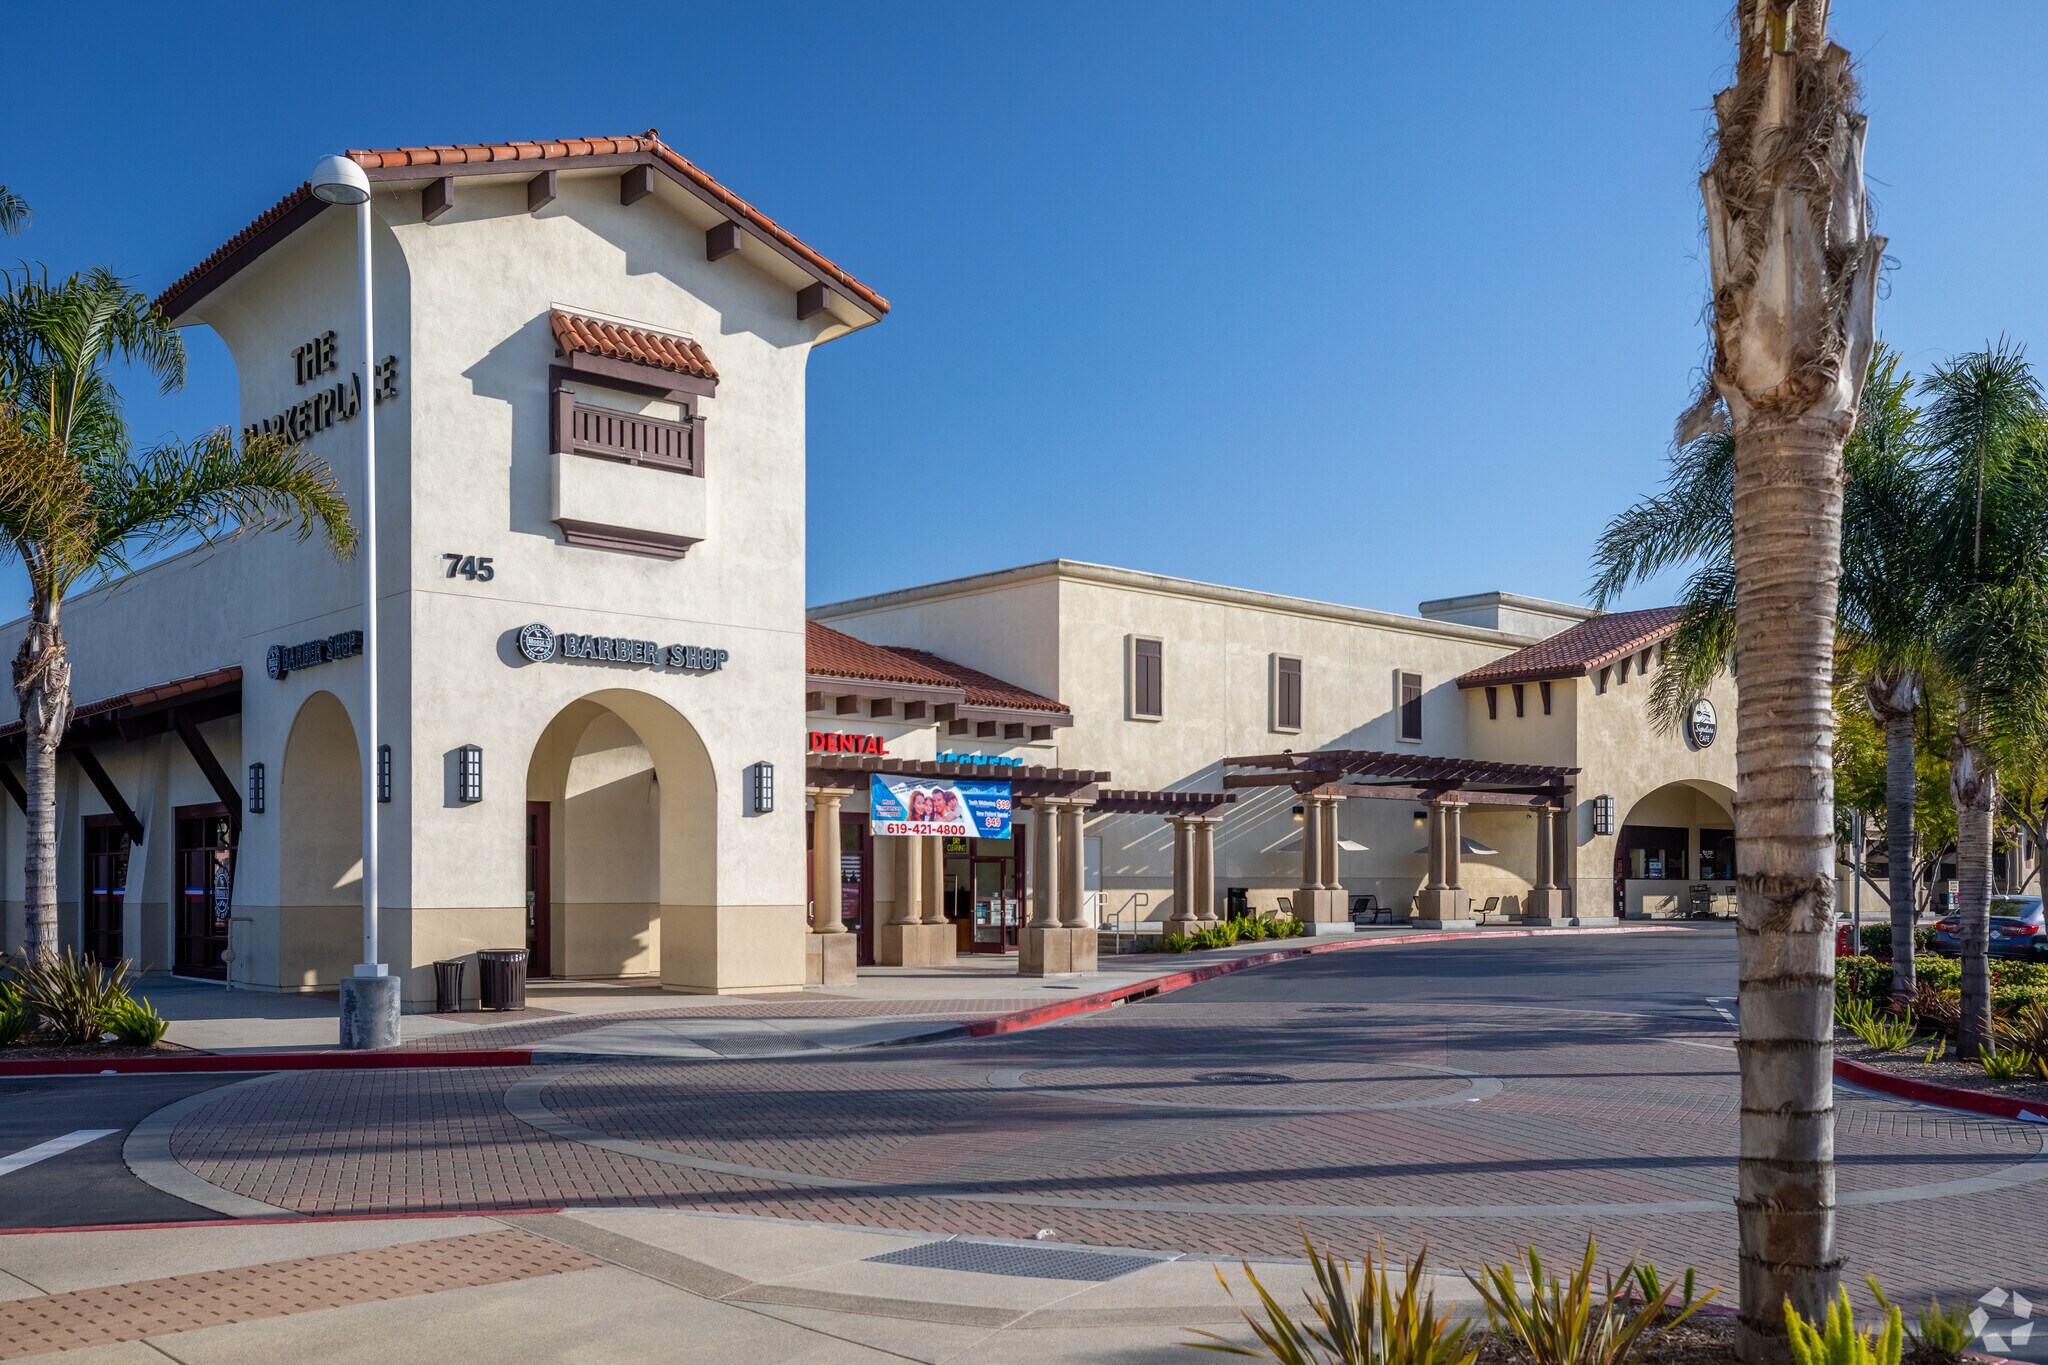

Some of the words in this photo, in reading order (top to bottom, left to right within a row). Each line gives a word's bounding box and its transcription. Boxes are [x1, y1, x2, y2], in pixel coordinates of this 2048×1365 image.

[291, 330, 335, 385] THE
[442, 553, 494, 582] 745
[282, 640, 325, 671] BARBER
[327, 630, 360, 661] SHOP
[563, 633, 660, 665] BARBER
[669, 643, 729, 671] SHOP
[809, 731, 890, 755] DENTAL
[996, 799, 1010, 809] $99
[887, 823, 966, 836] 619-421-4800
[986, 817, 1001, 827] $49
